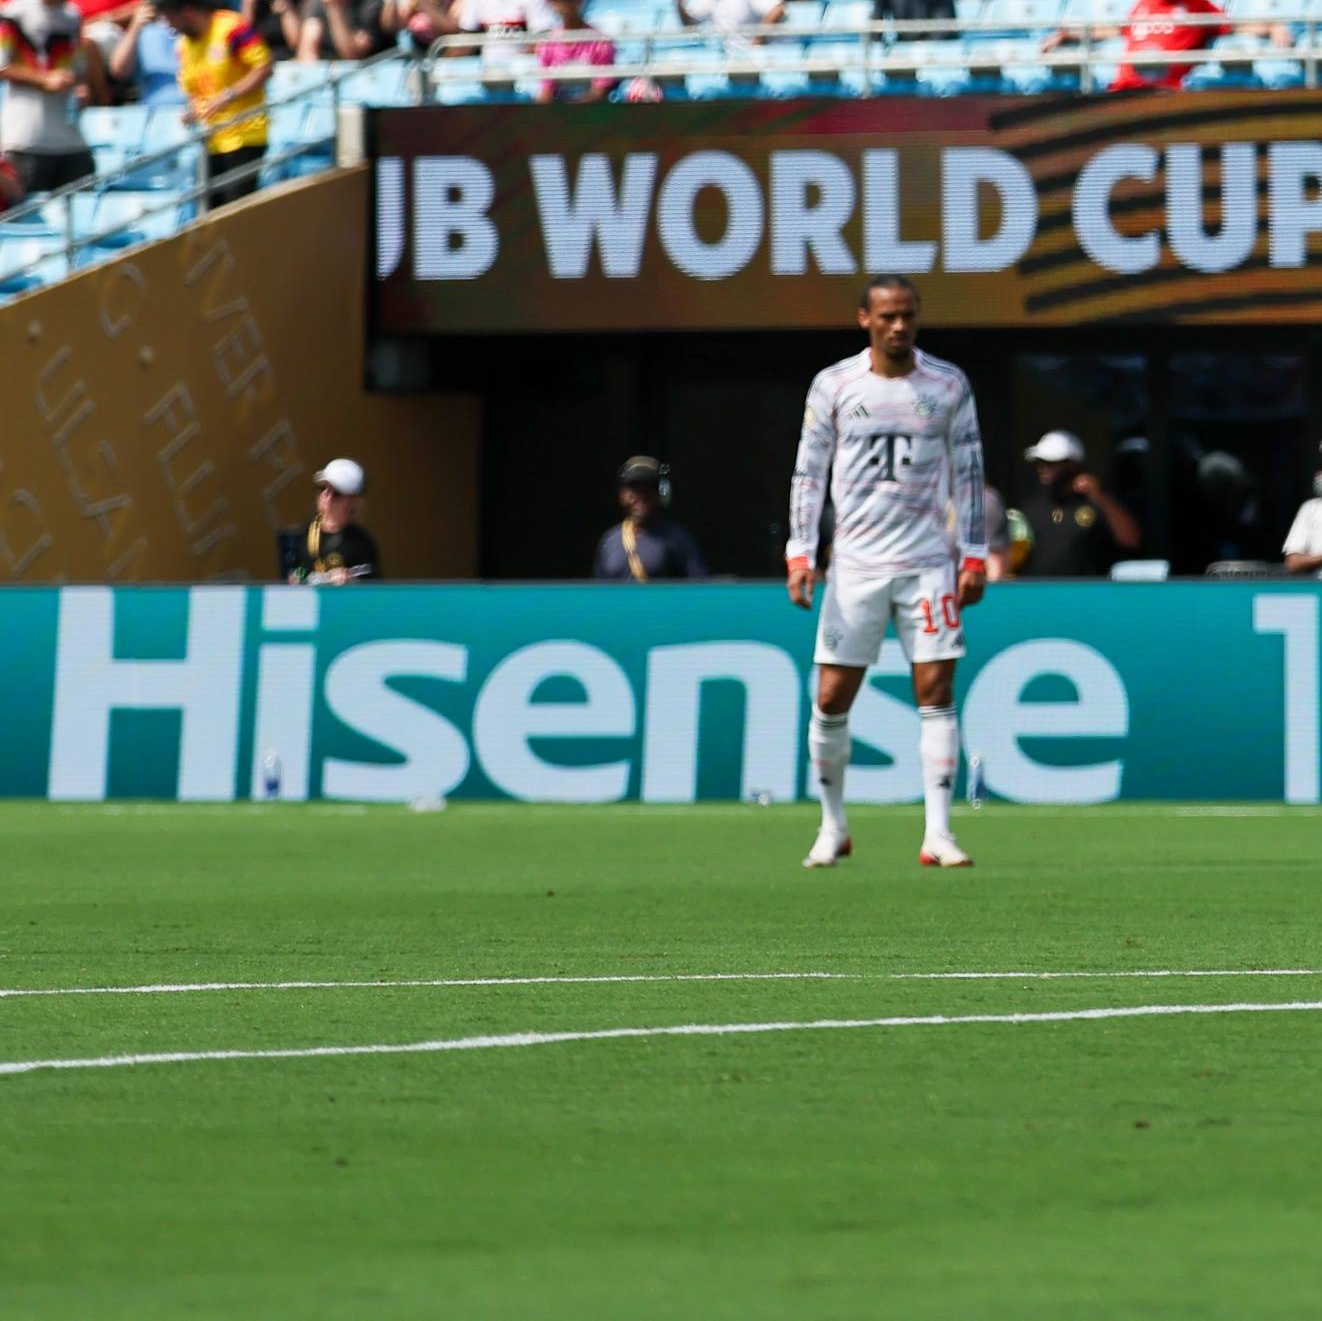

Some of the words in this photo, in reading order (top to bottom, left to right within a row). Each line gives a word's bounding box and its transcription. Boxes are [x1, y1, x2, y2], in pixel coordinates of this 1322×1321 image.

[529, 145, 1040, 281] WORLD
[921, 595, 960, 633] 10
[46, 586, 1130, 804] Hisense
